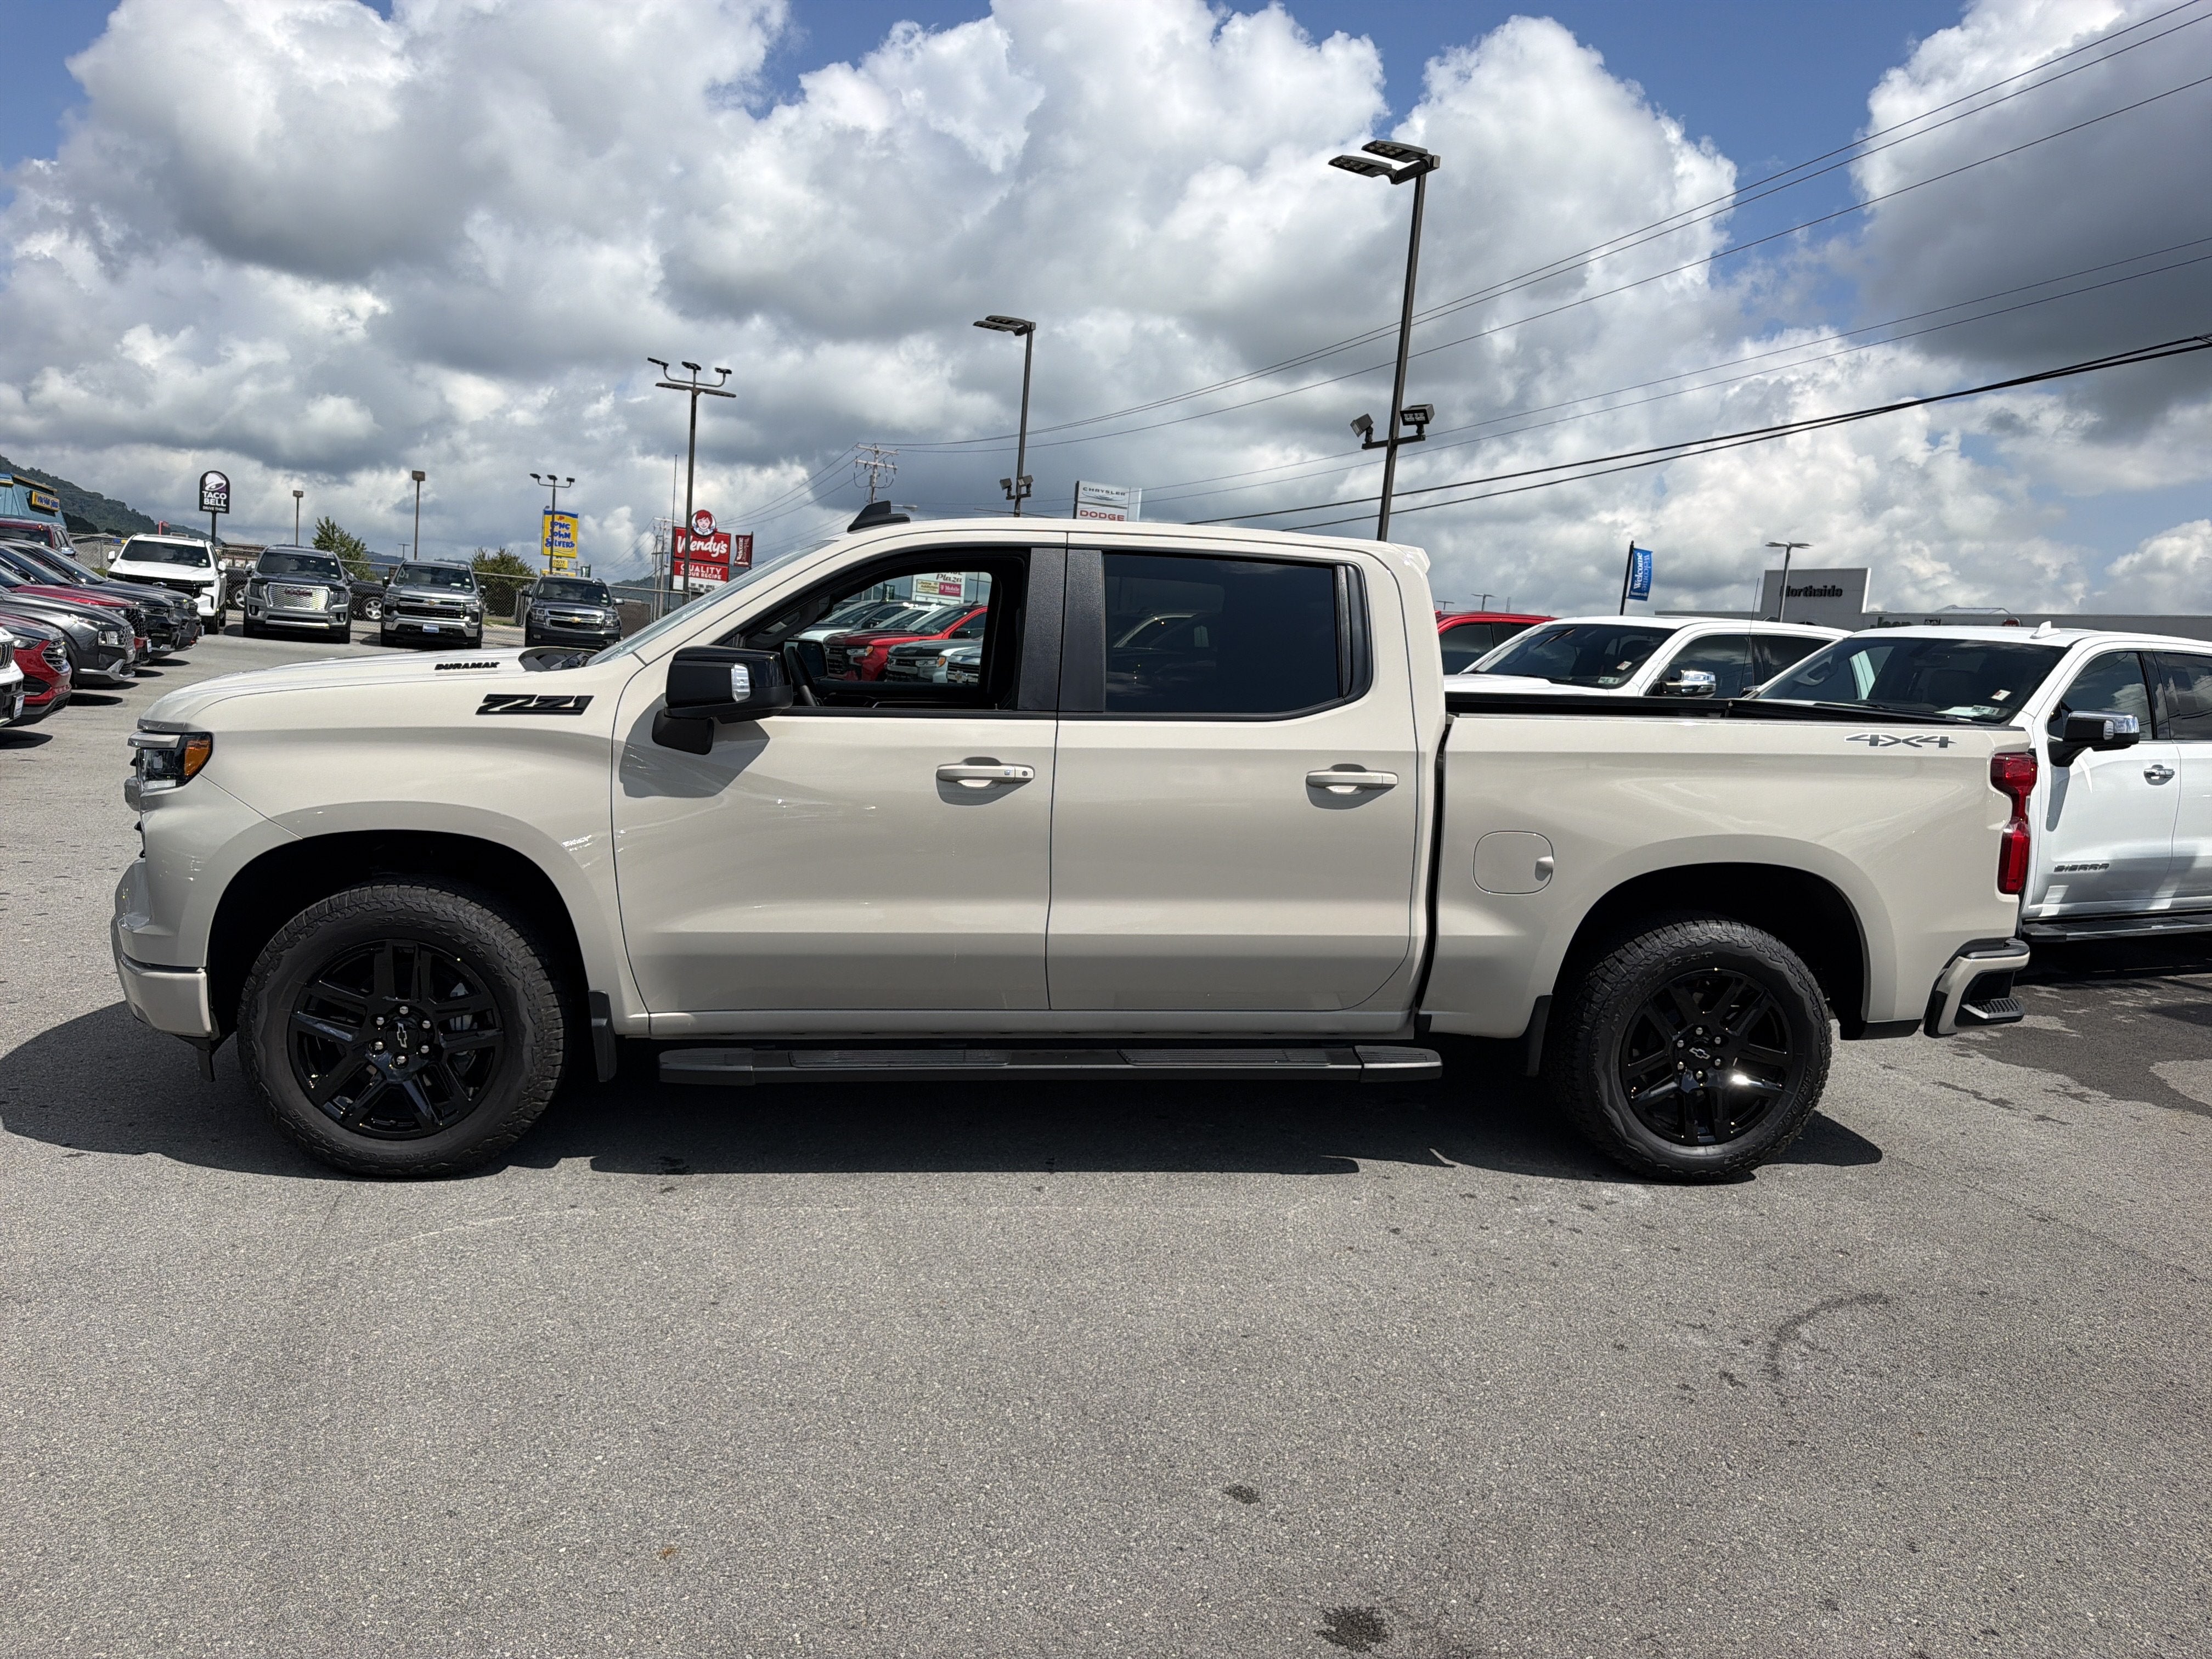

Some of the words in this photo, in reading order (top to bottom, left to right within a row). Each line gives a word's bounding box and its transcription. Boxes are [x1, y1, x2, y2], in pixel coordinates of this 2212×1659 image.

[202, 491, 227, 500] TACO
[1082, 487, 1126, 496] CHRYSLER
[204, 498, 227, 507] BELL
[1080, 510, 1125, 521] DODGE
[677, 535, 728, 557] Wendy's
[1633, 552, 1643, 589] Welcome
[1641, 554, 1651, 591] Welcome
[935, 573, 962, 583] Plaza
[434, 662, 500, 670] DURAMAX
[475, 693, 595, 716] Z71
[2053, 862, 2110, 873] SIERRA
